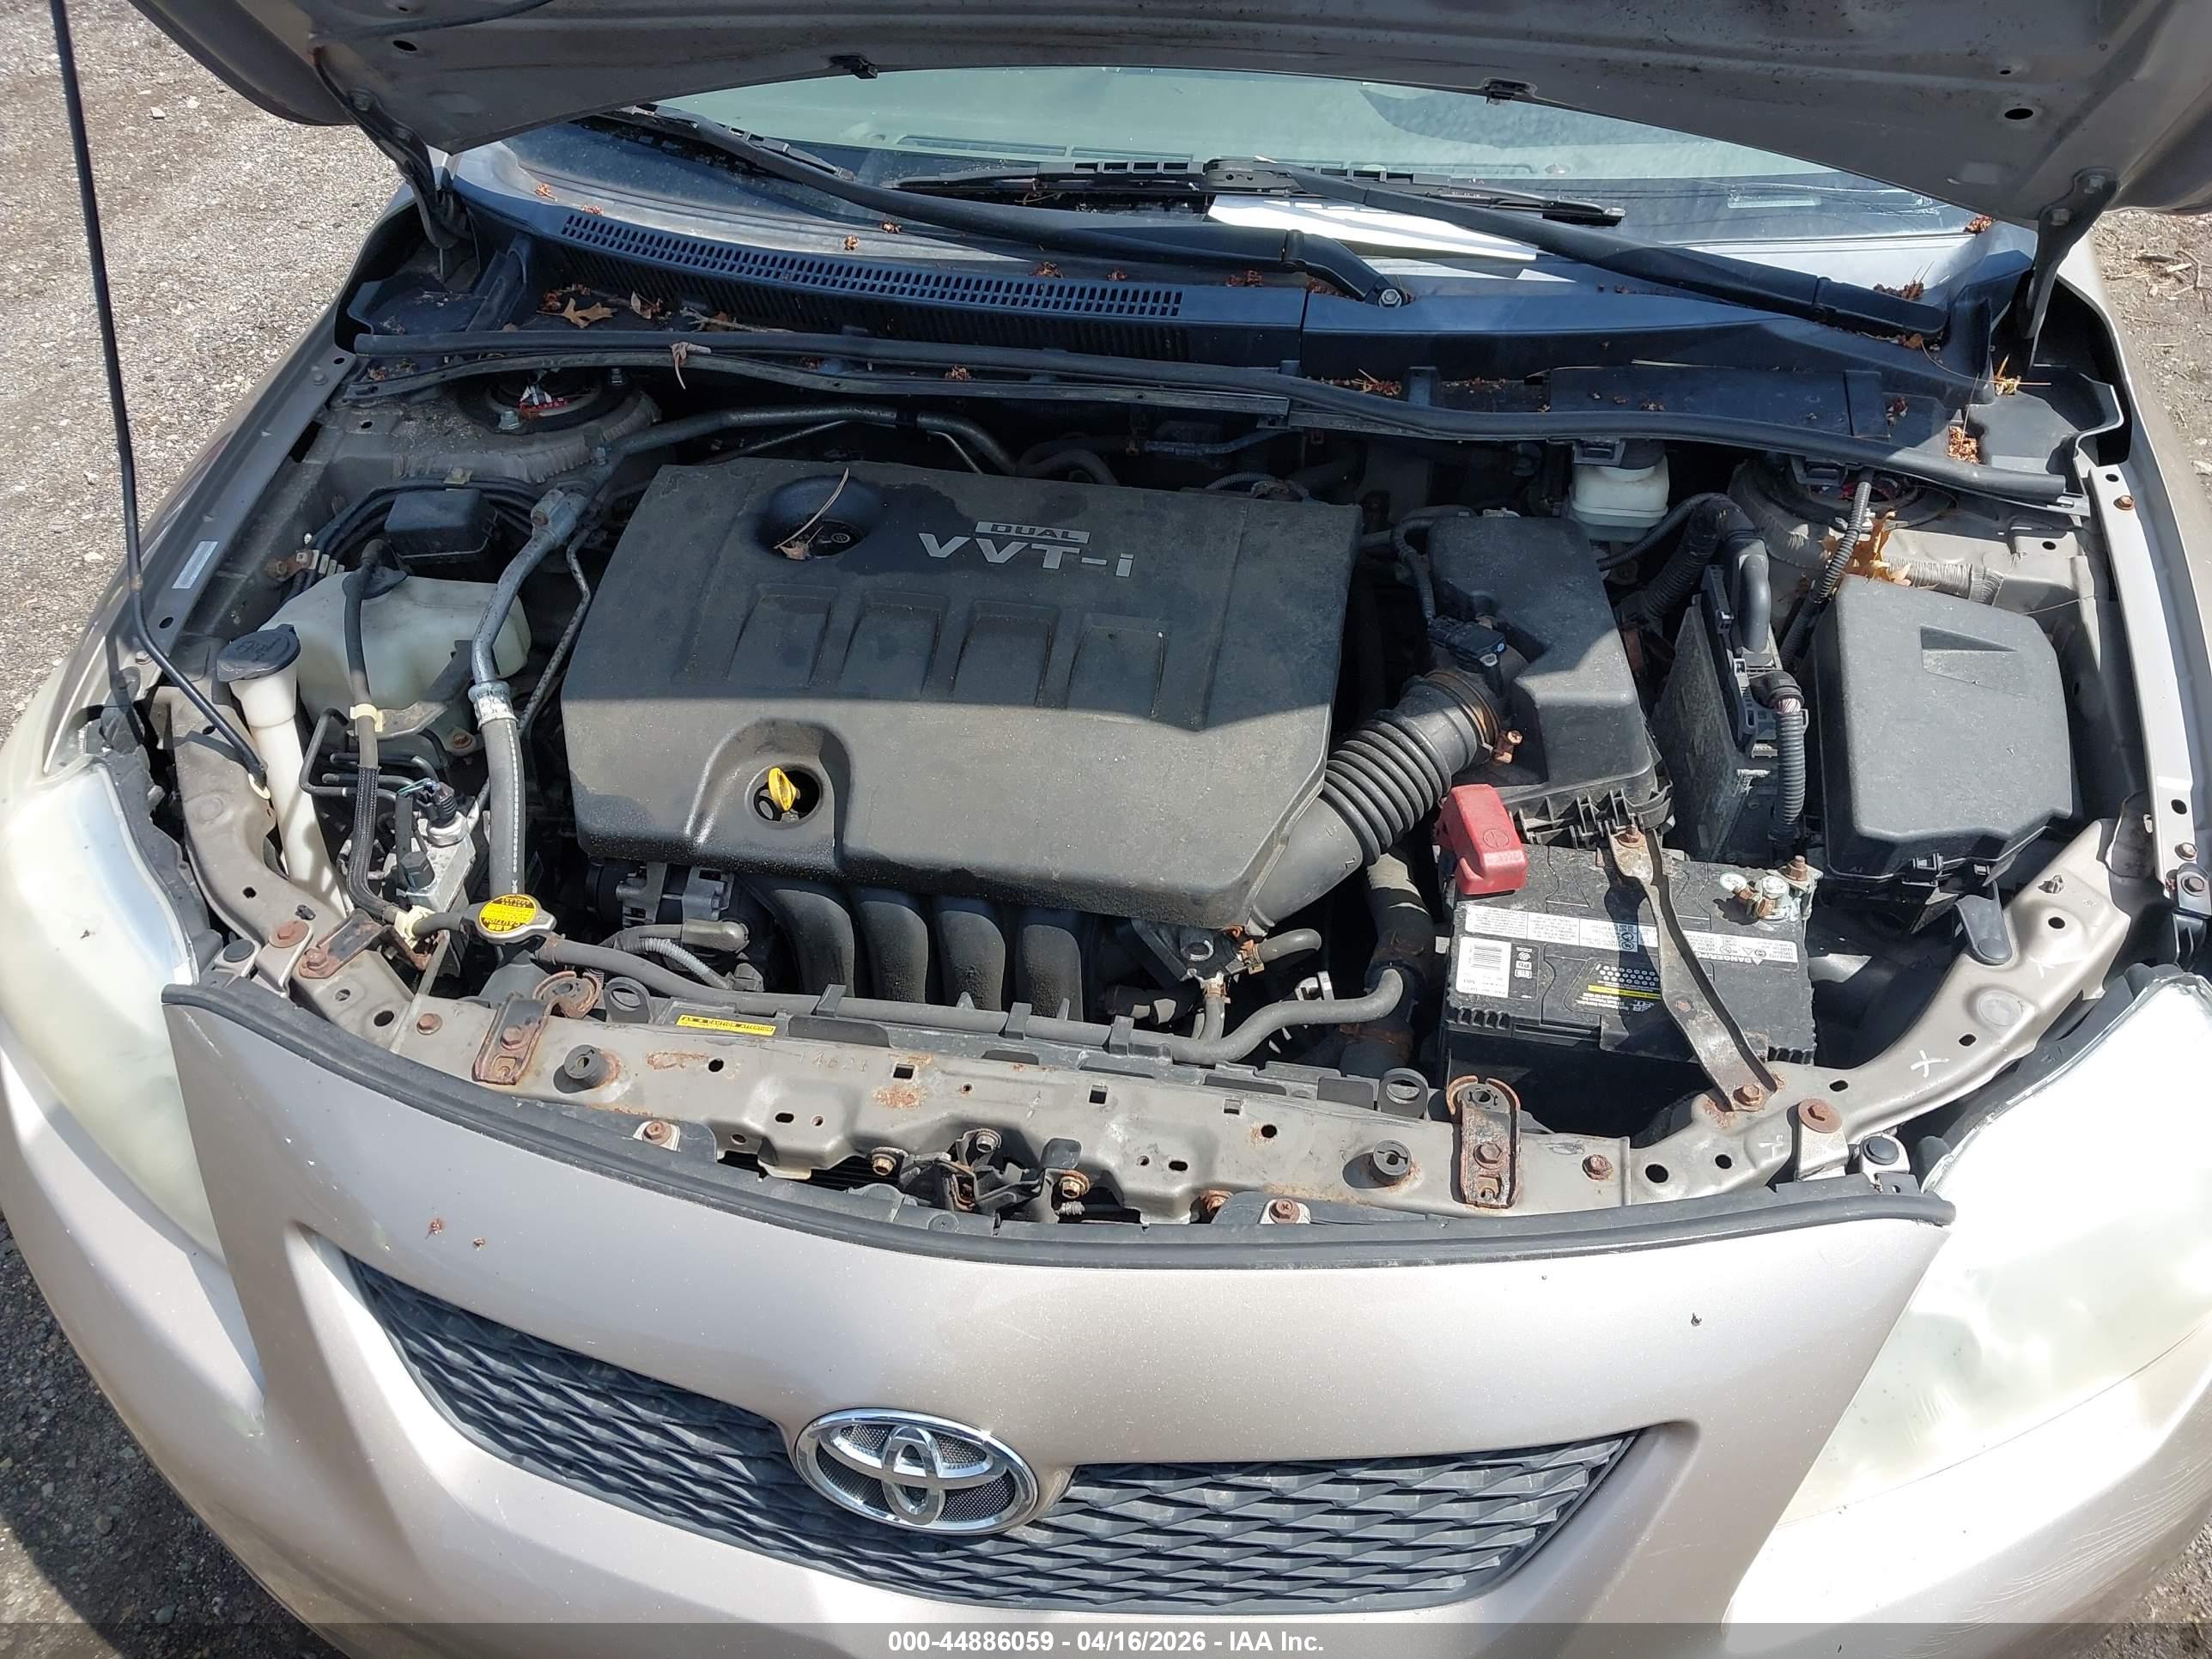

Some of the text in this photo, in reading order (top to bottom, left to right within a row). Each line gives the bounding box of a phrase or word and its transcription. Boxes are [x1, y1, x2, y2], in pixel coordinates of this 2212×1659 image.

[991, 523, 1079, 541] DUAL
[918, 533, 1133, 577] VVT-i
[483, 918, 520, 927] CAUTION
[1694, 951, 1753, 963] DANGER/PO
[707, 1019, 737, 1028] CAUTION
[740, 1024, 773, 1032] ATTENTION
